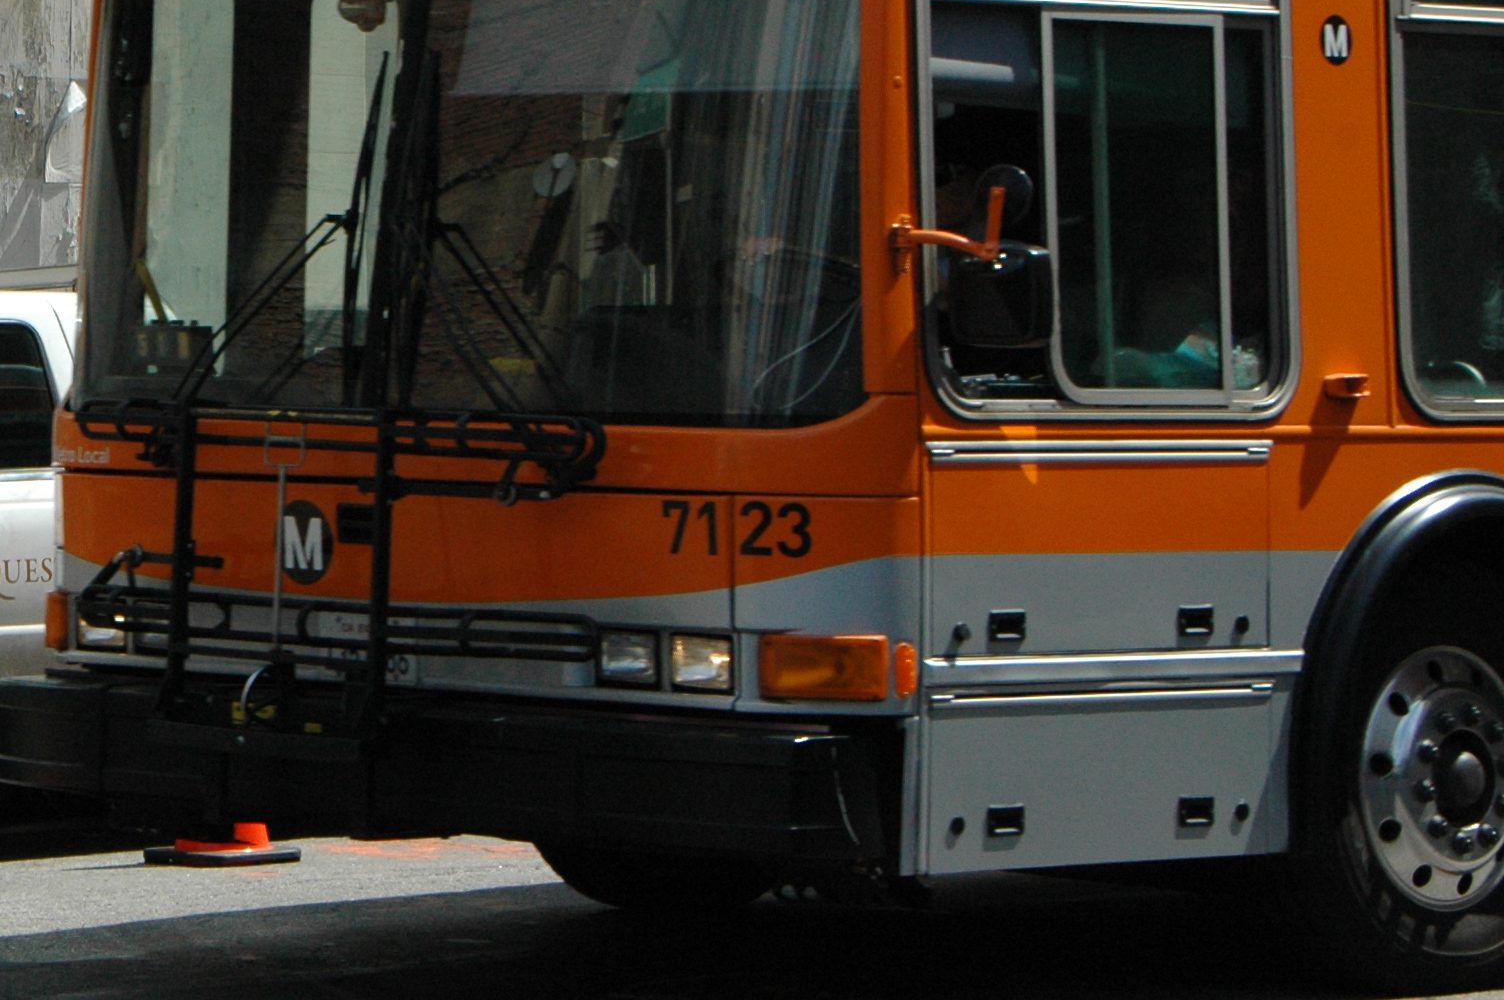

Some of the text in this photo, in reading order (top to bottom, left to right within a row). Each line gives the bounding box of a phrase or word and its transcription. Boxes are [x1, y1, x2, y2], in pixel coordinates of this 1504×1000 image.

[1324, 24, 1348, 57] M
[285, 516, 325, 571] M
[662, 500, 813, 557] 7123
